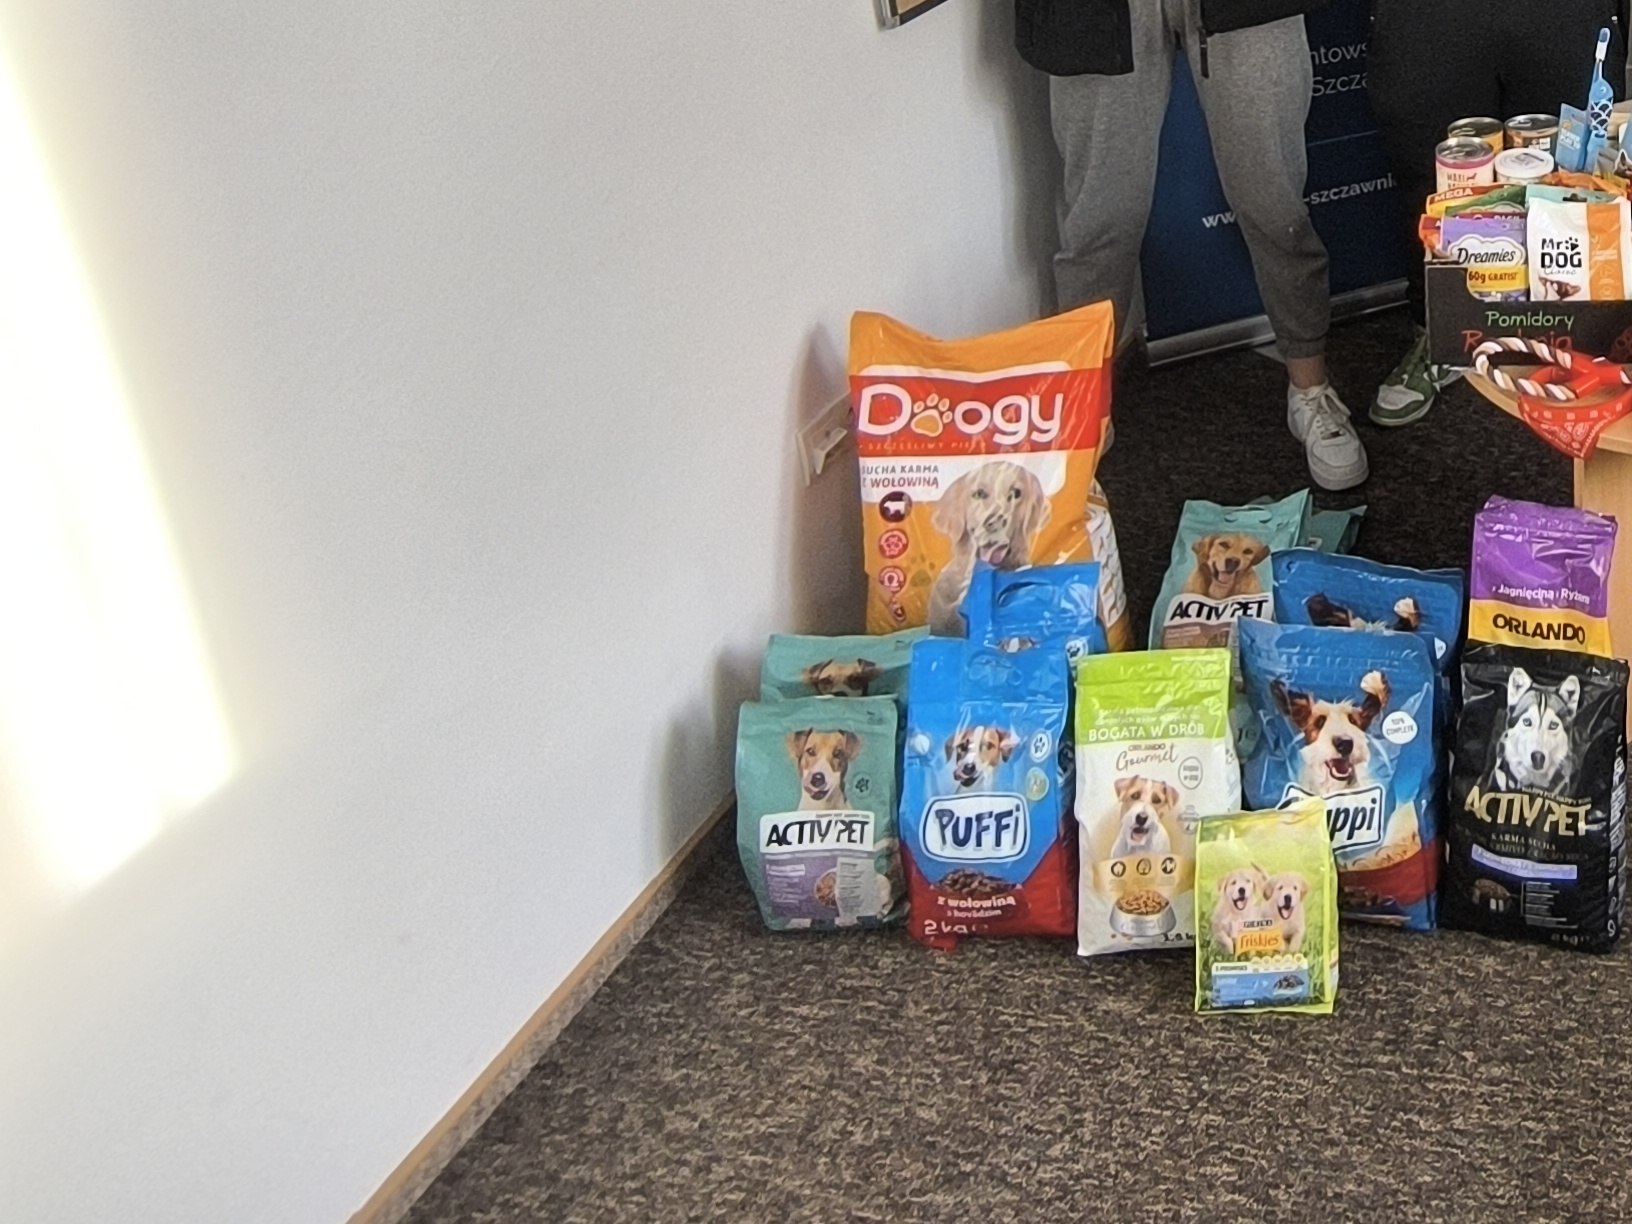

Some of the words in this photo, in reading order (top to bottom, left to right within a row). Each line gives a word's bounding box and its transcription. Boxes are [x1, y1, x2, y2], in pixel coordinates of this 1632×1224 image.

[1434, 187, 1474, 202] MEGA
[1457, 247, 1516, 265] Dreamies
[1540, 252, 1582, 269] DOG
[1468, 271, 1486, 283] 60g
[1485, 310, 1575, 330] Pomidory
[900, 464, 939, 473] KARMA
[870, 476, 939, 489] WOŁOWINĄ
[1492, 613, 1586, 645] ORLANDO
[1088, 725, 1146, 742] BOGATA
[1150, 724, 1163, 737] W
[1116, 743, 1178, 772] Gourmet
[1327, 797, 1377, 841] ppi
[1491, 832, 1525, 844] KARMA
[923, 919, 939, 935] 2
